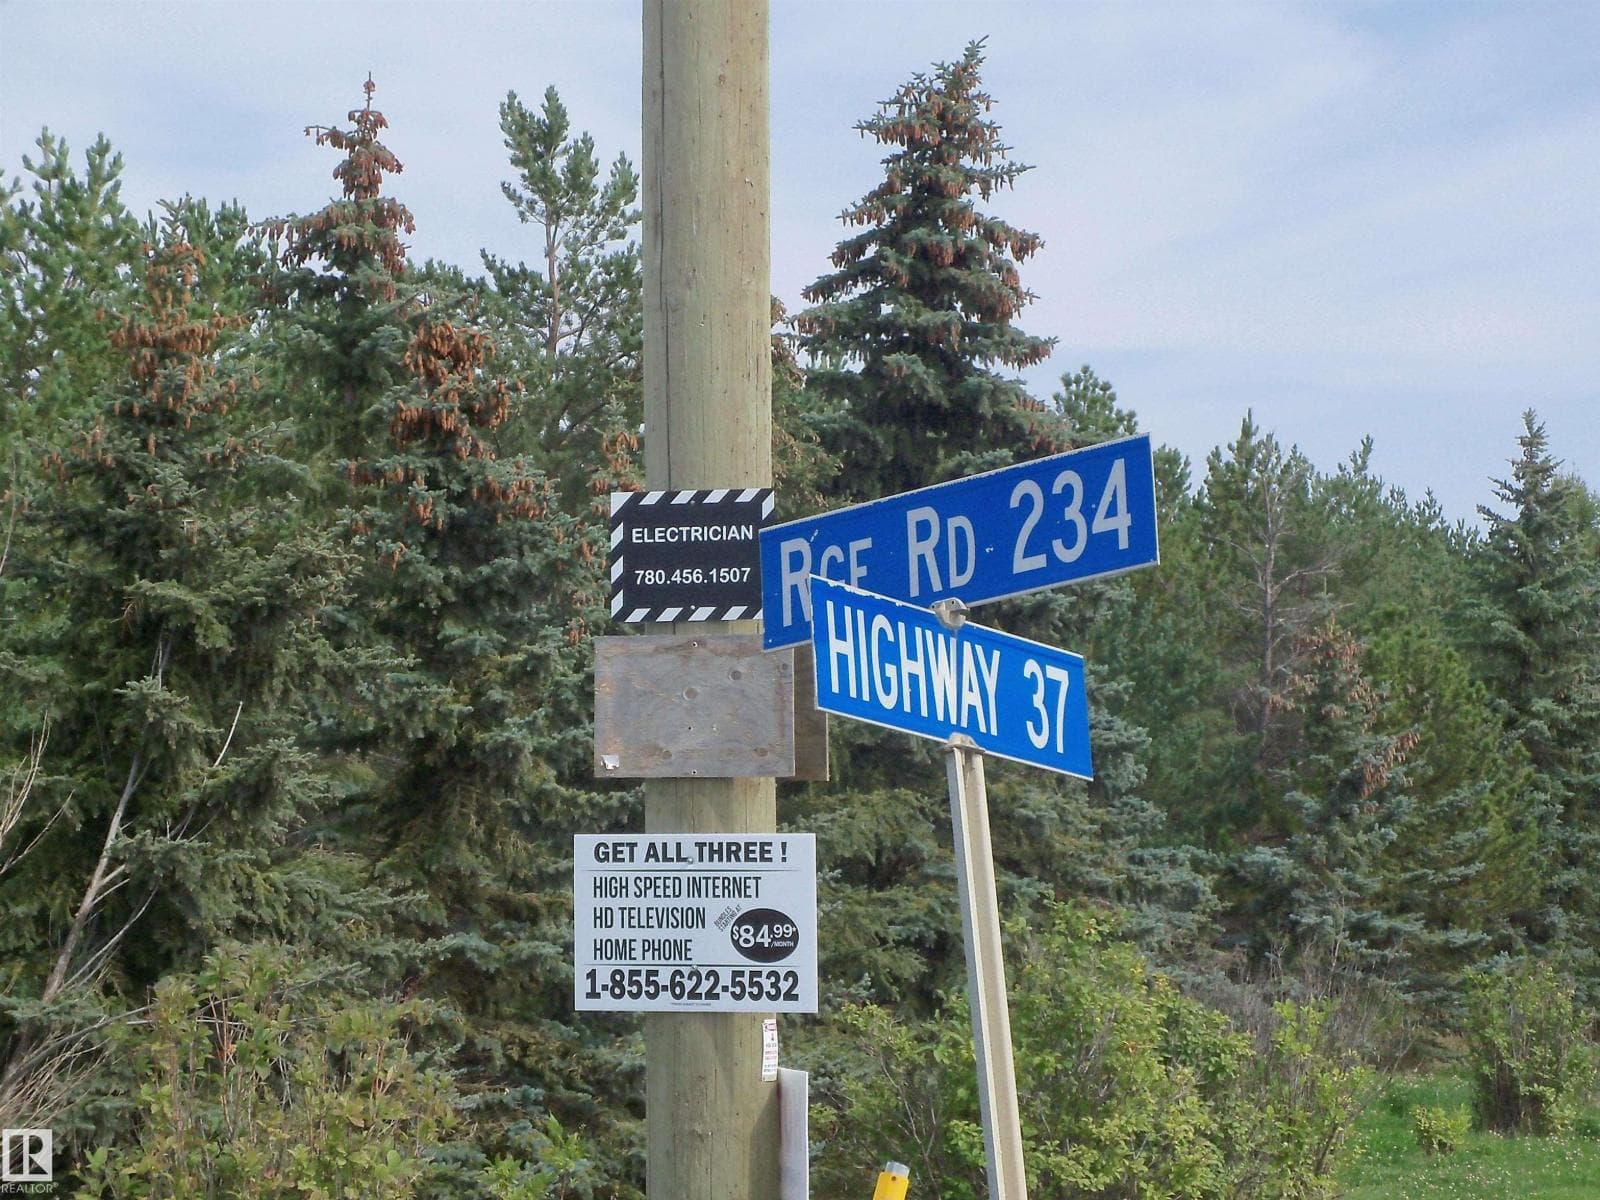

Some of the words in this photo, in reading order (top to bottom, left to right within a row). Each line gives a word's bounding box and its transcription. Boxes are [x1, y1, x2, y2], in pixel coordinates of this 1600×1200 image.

[632, 525, 753, 543] ELECTRICIAN
[907, 505, 976, 598] RD
[1009, 457, 1132, 574] 234
[634, 567, 751, 585] 780.456.1507
[826, 600, 1001, 736] HIGHWAY
[1023, 658, 1070, 754] 37
[593, 842, 638, 863] GET
[644, 842, 689, 863] ALL
[694, 841, 773, 863] THREE
[593, 876, 629, 899] HIGH
[634, 876, 682, 899] SPEED
[687, 876, 762, 899] INTERNET
[593, 906, 614, 929] HD
[618, 906, 706, 929] TELEVISION
[593, 938, 637, 961] HOME
[641, 938, 693, 961] PHONE
[585, 968, 800, 1002] 1-855-622-5532
